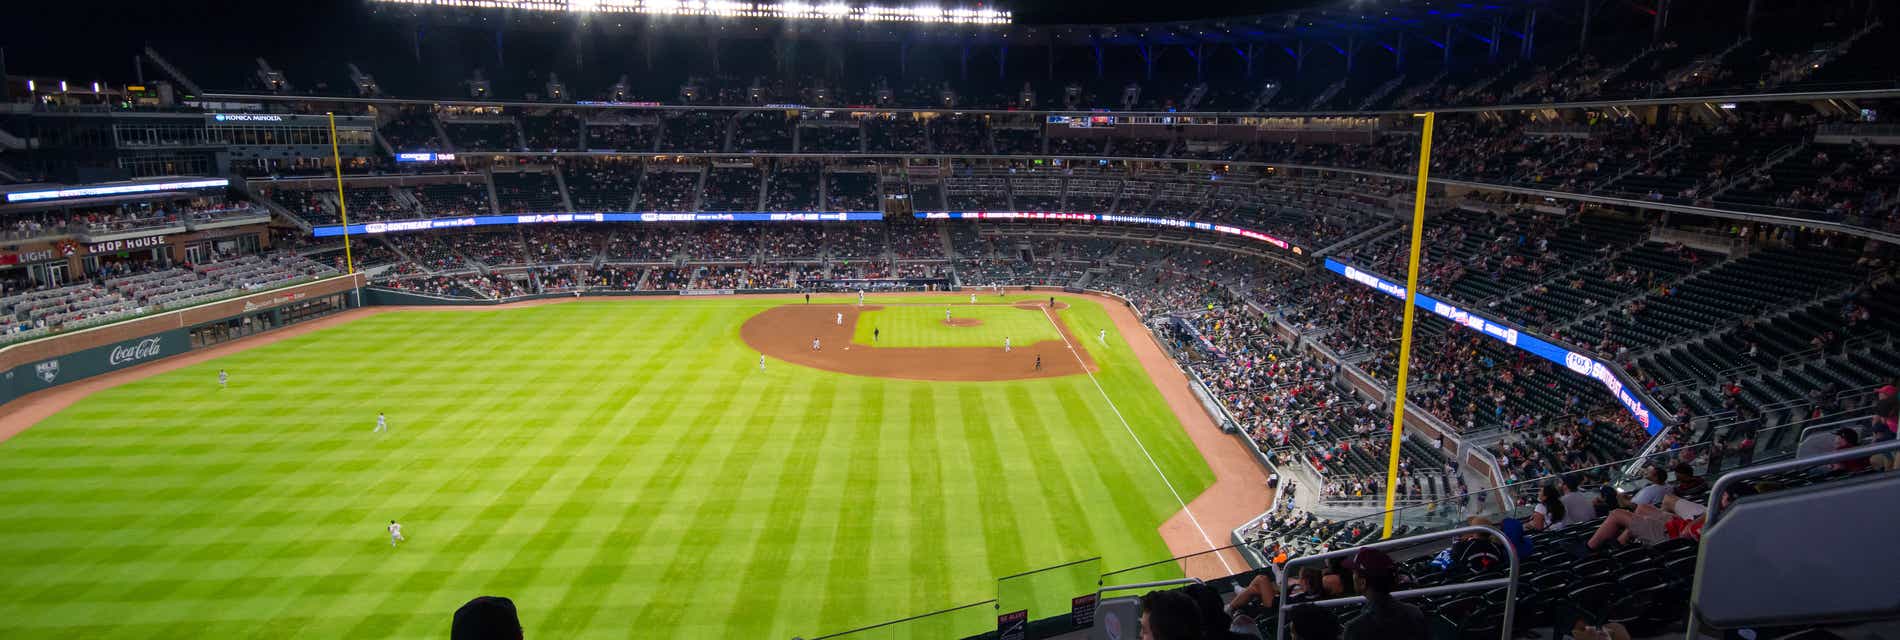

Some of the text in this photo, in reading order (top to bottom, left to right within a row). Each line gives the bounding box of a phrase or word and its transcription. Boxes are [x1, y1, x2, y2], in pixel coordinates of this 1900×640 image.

[88, 235, 166, 253] CHOP HOUSE
[19, 250, 53, 263] LIGHT
